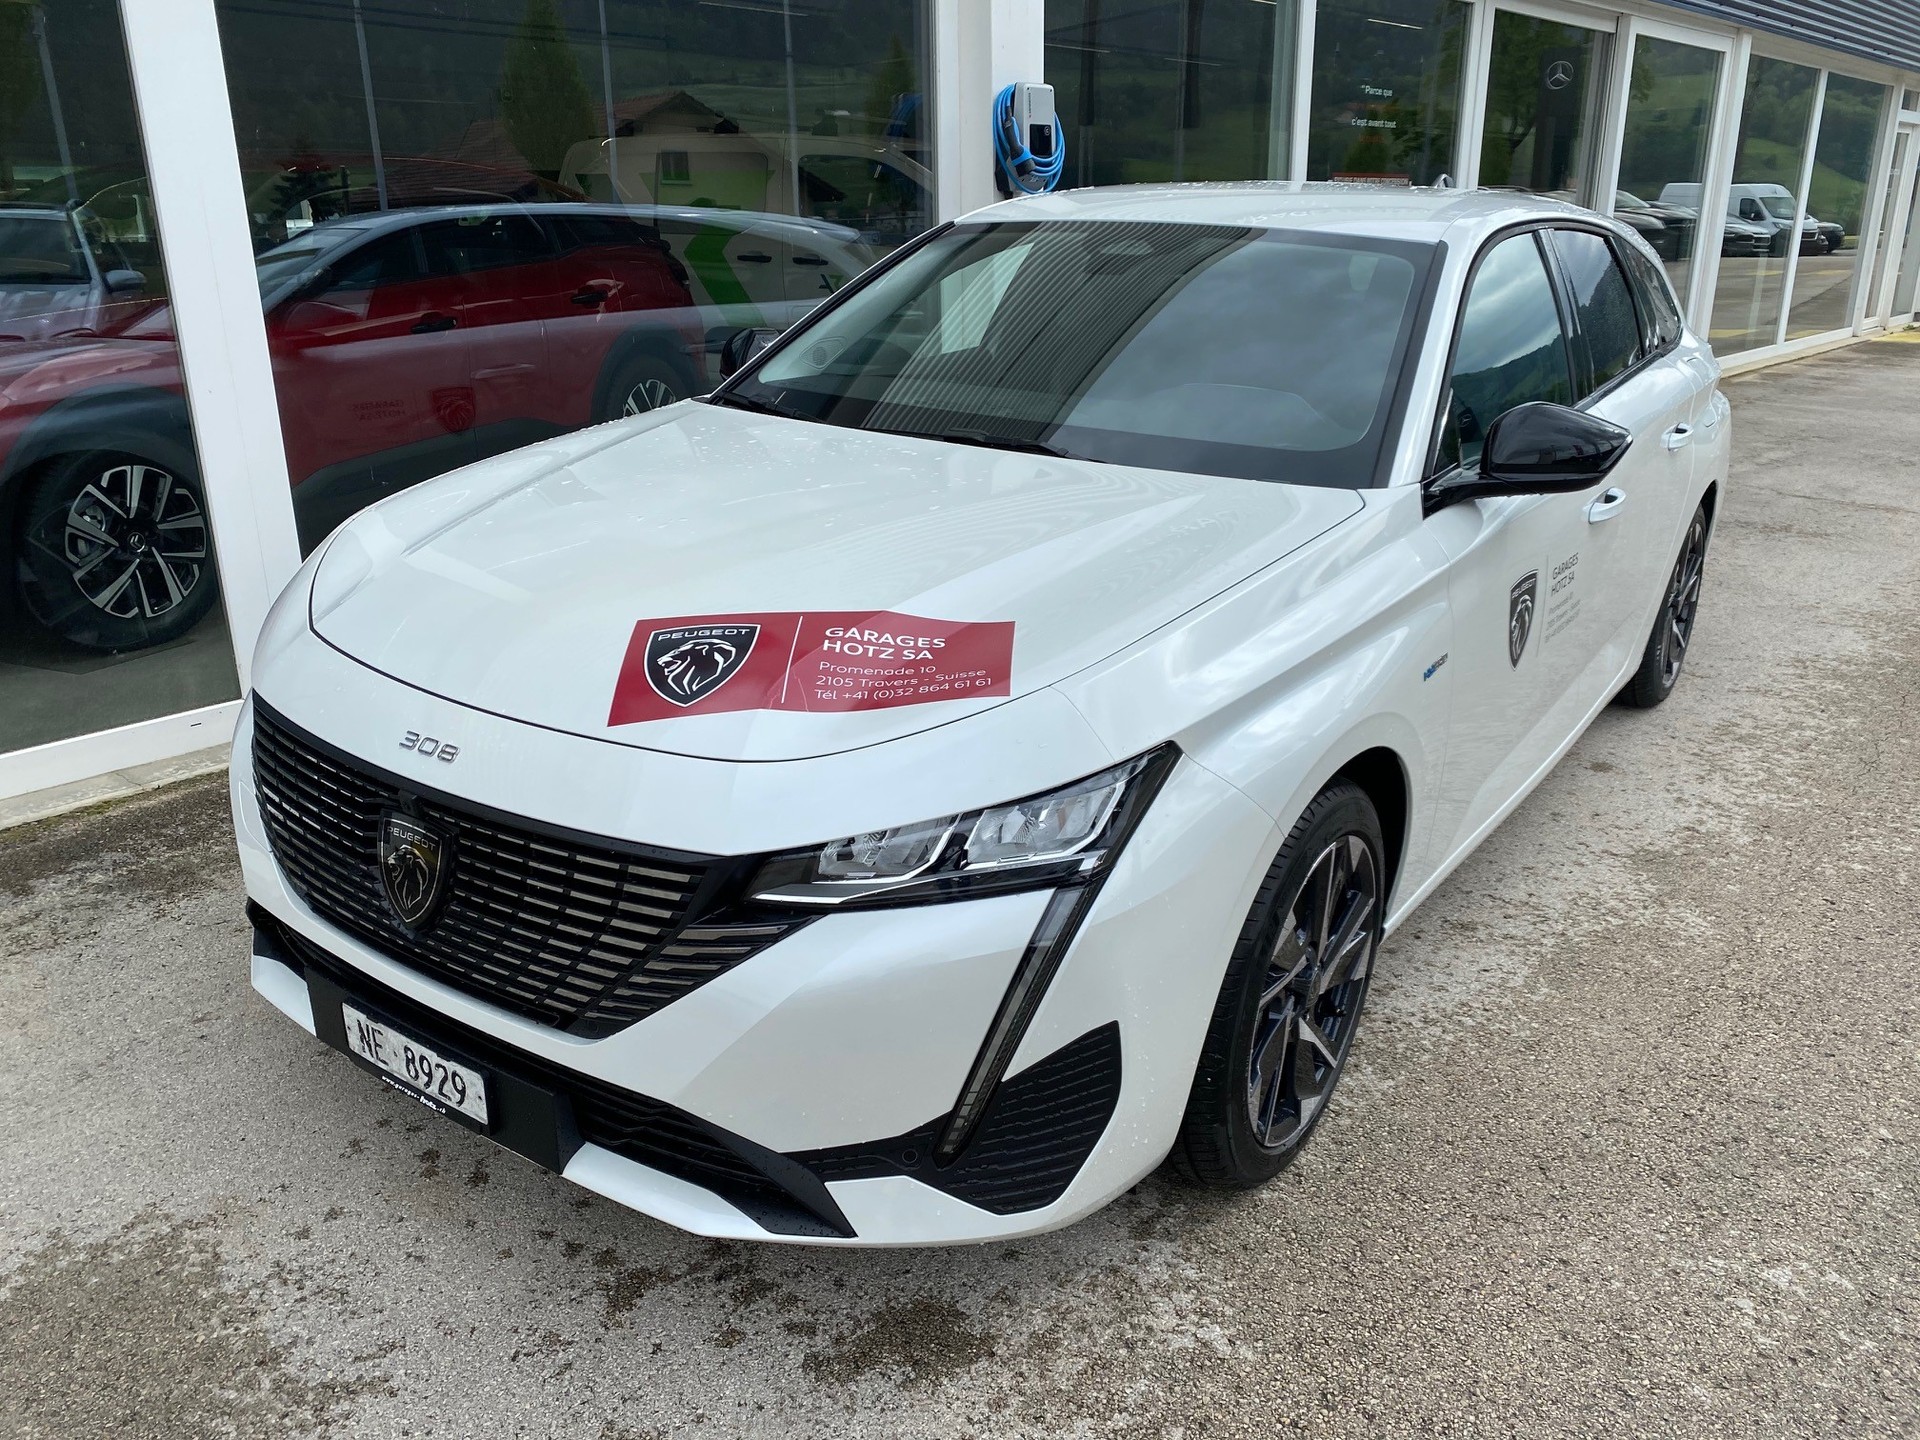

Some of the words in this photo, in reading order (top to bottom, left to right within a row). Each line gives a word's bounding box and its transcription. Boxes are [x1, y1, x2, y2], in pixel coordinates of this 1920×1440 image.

[1552, 551, 1579, 580] GARAGES
[657, 628, 750, 641] PEUGEOT
[825, 627, 946, 648] GARAGES
[822, 639, 895, 659] HOTZ
[902, 649, 934, 660] SA
[815, 675, 854, 688] 2105
[858, 677, 919, 688] Travers
[935, 669, 987, 682] Suisse
[819, 661, 915, 676] Promenade
[919, 665, 936, 674] 10
[814, 688, 837, 700] Tél
[842, 690, 868, 700] +41
[873, 687, 914, 701] (0)32
[919, 683, 950, 693] 864
[954, 679, 971, 689] 61
[975, 677, 992, 687] 61
[398, 730, 460, 764] 308
[386, 826, 436, 851] PEUGEOT
[356, 1019, 390, 1067] NE
[403, 1045, 467, 1108] 8929
